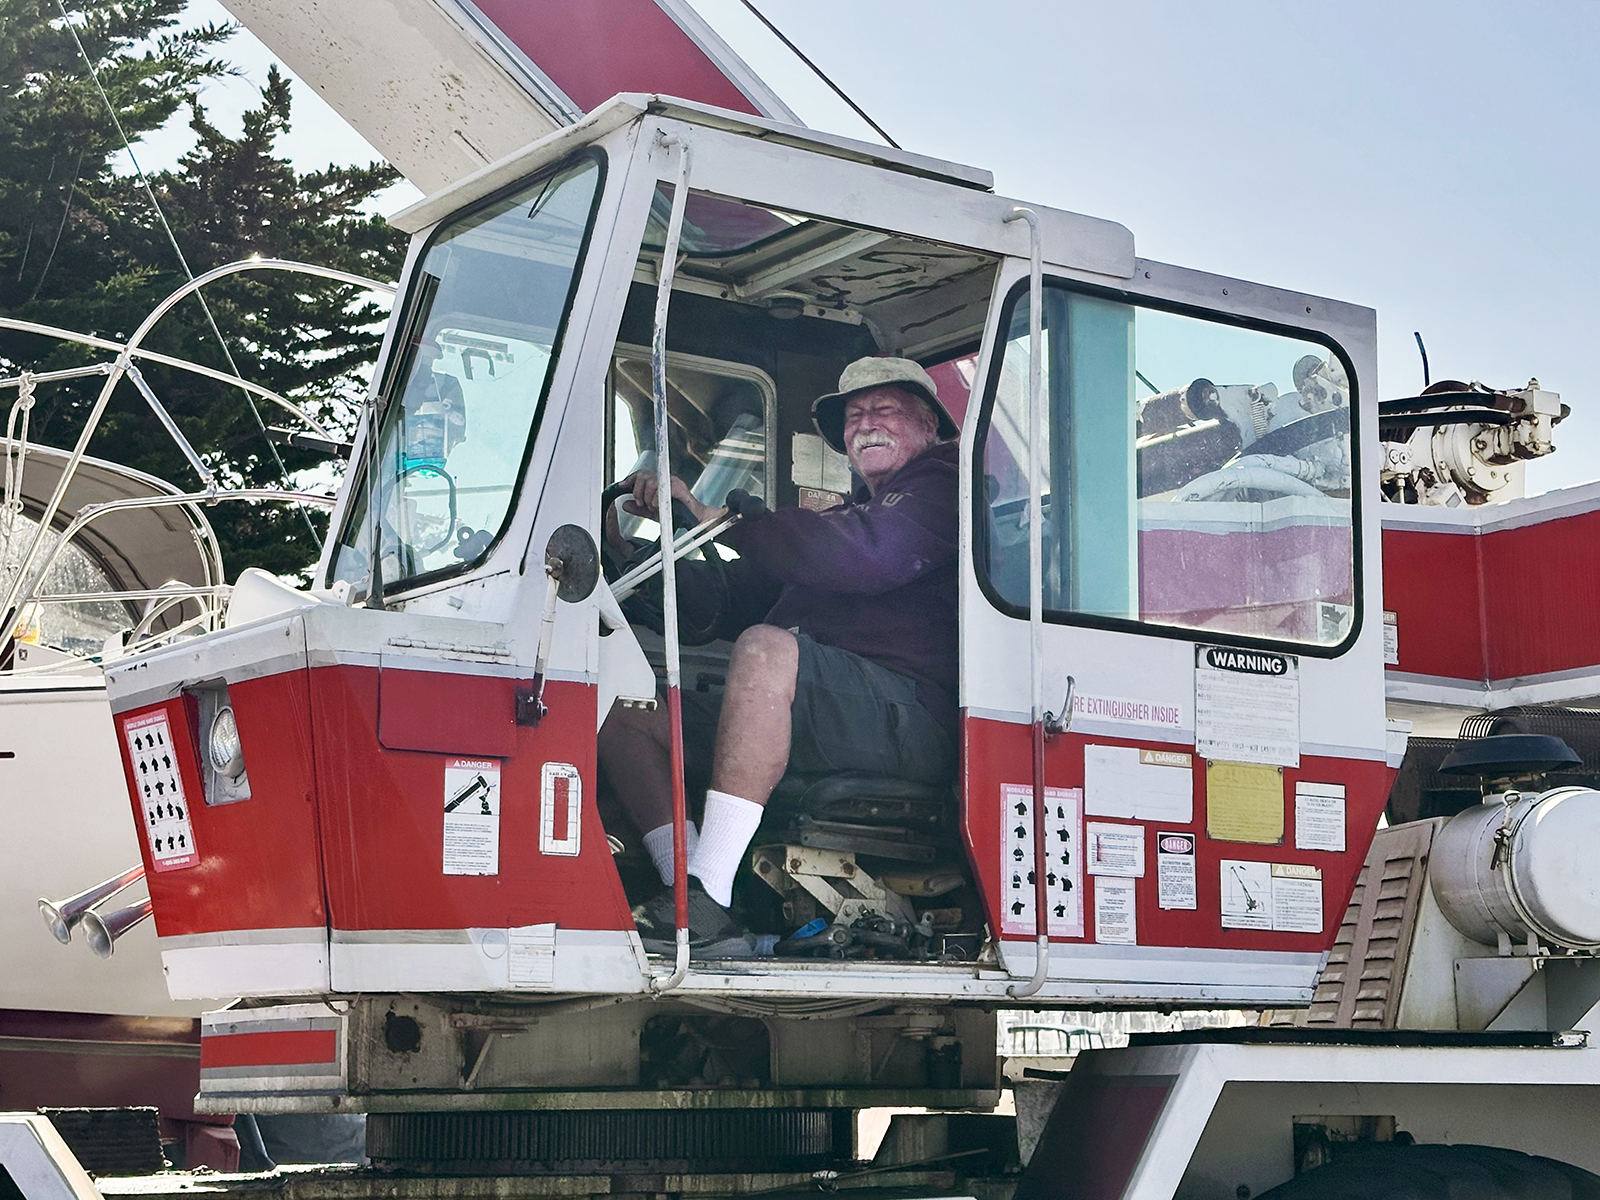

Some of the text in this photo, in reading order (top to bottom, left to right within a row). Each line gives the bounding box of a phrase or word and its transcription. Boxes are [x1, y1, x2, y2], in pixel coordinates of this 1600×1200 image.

[808, 491, 836, 502] DAER
[1213, 651, 1282, 673] WARNING
[1074, 696, 1179, 724] RE EXTINGUISHER INSIDE
[1155, 753, 1187, 764] DANGER
[461, 760, 492, 769] DANGER
[1164, 839, 1188, 851] DANGER
[1286, 866, 1317, 877] DANGER
